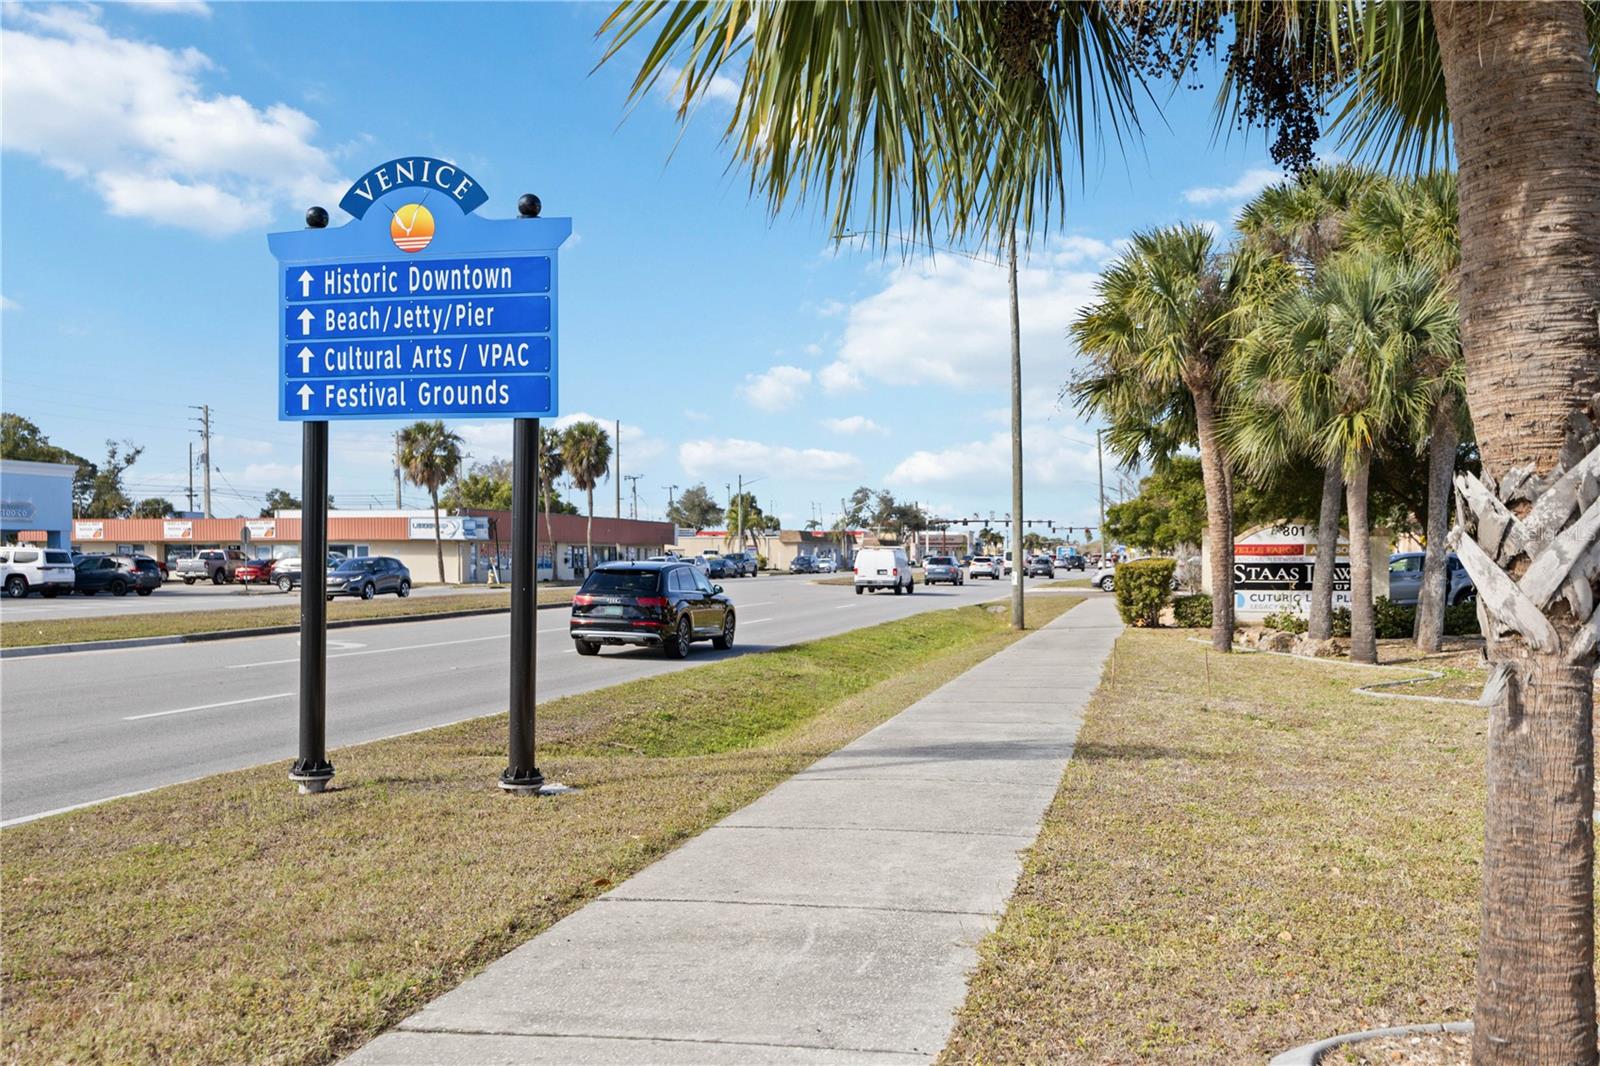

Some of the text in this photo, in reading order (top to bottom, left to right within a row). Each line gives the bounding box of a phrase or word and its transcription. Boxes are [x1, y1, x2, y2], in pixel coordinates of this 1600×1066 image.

[355, 160, 473, 202] VENICE
[324, 264, 512, 295] Historic Downtown
[326, 302, 494, 334] Beach/Jetty/Pier
[324, 343, 529, 371] Cultural Arts / VPAC
[326, 379, 509, 408] Festival Grounds
[1282, 526, 1305, 536] 801
[1234, 564, 1299, 584] STAAS
[1250, 593, 1302, 602] CUTURIC
